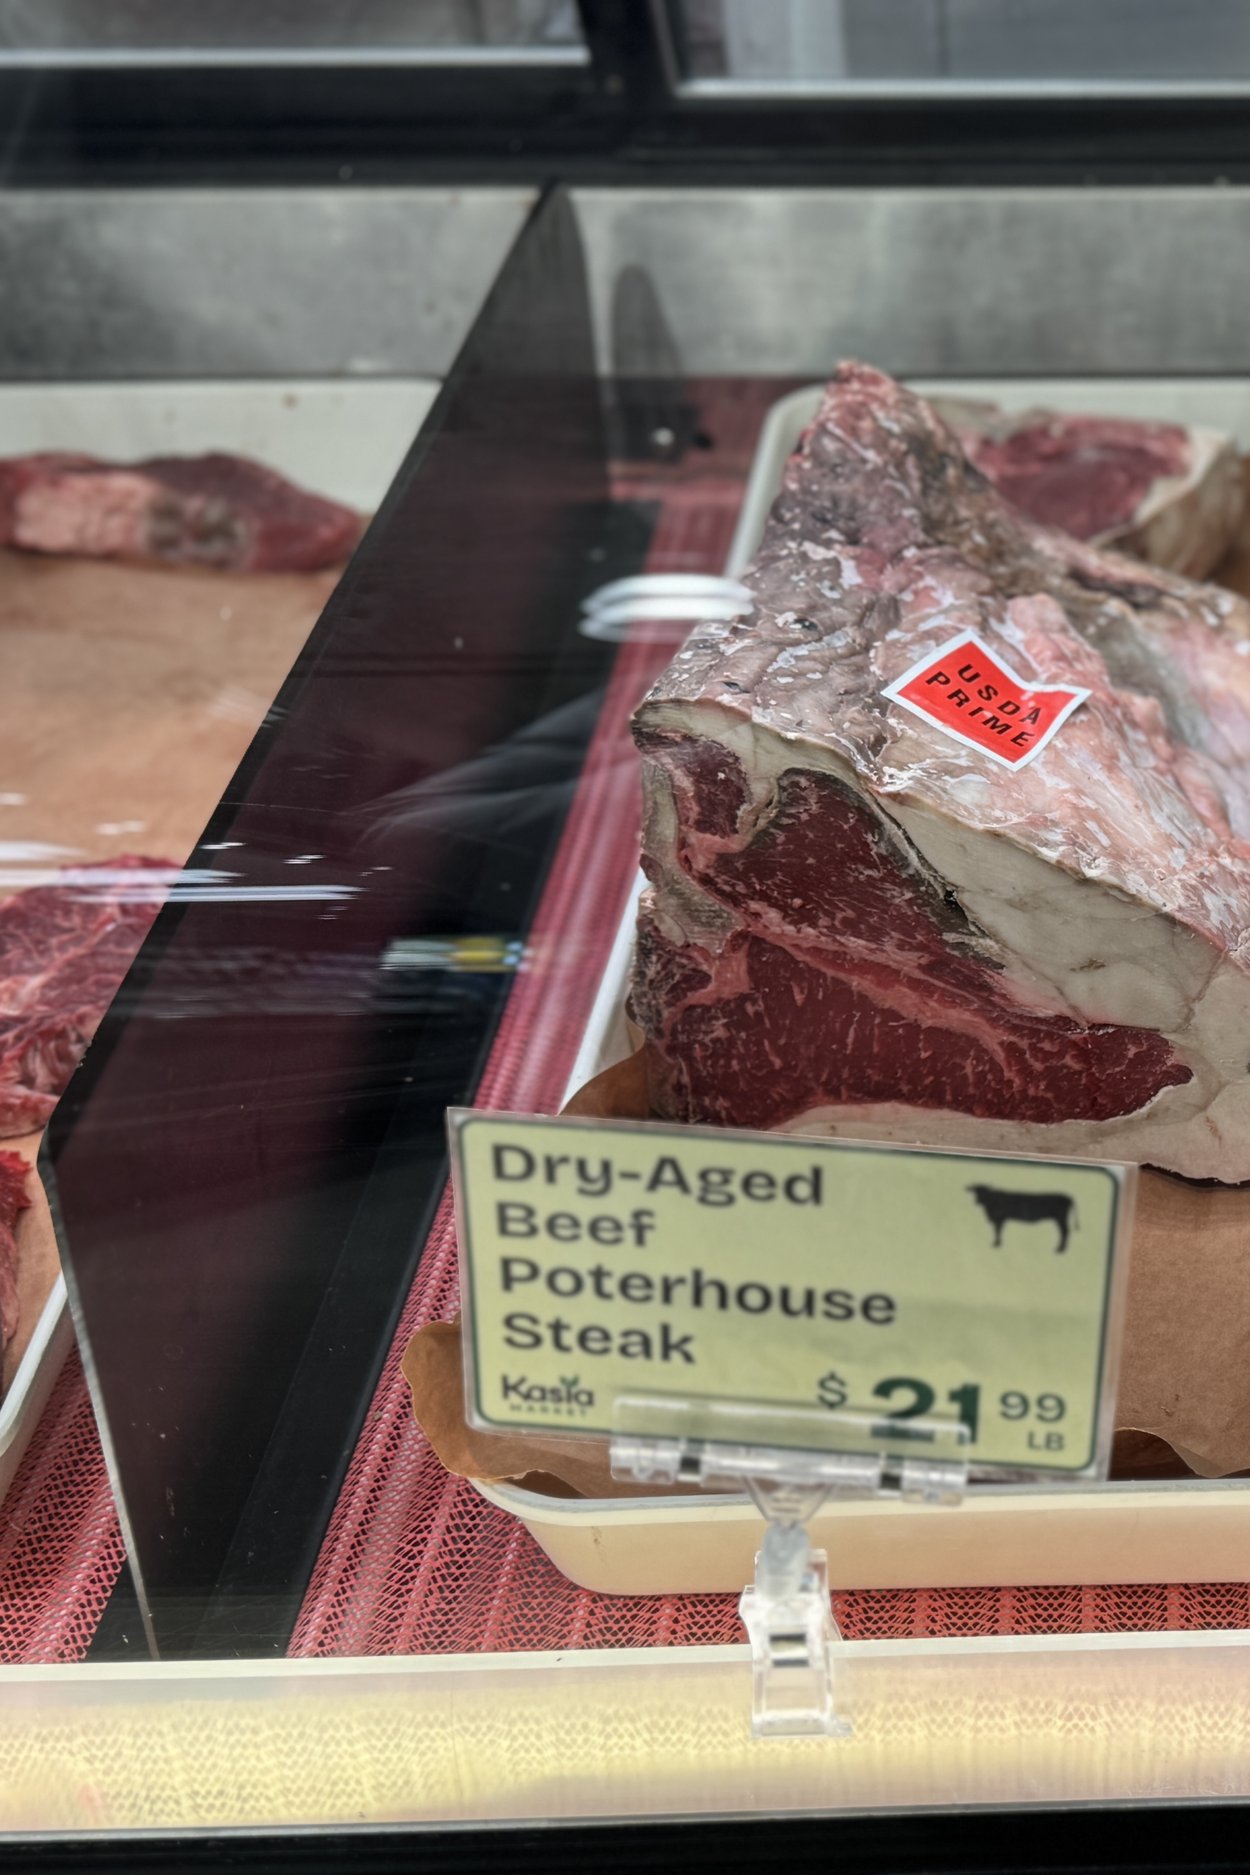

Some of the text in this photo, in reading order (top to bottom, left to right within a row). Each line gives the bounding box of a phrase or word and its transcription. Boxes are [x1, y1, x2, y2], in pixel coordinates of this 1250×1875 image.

[925, 671, 1036, 747] PRIME
[957, 664, 1042, 725] USDA
[490, 1143, 824, 1207] Dry-Aged
[495, 1200, 657, 1249] Beef
[500, 1256, 897, 1325] Poterhouse
[503, 1312, 696, 1365] Steak
[817, 1371, 1066, 1445] $ 21 99
[1028, 1432, 1065, 1450] LB
